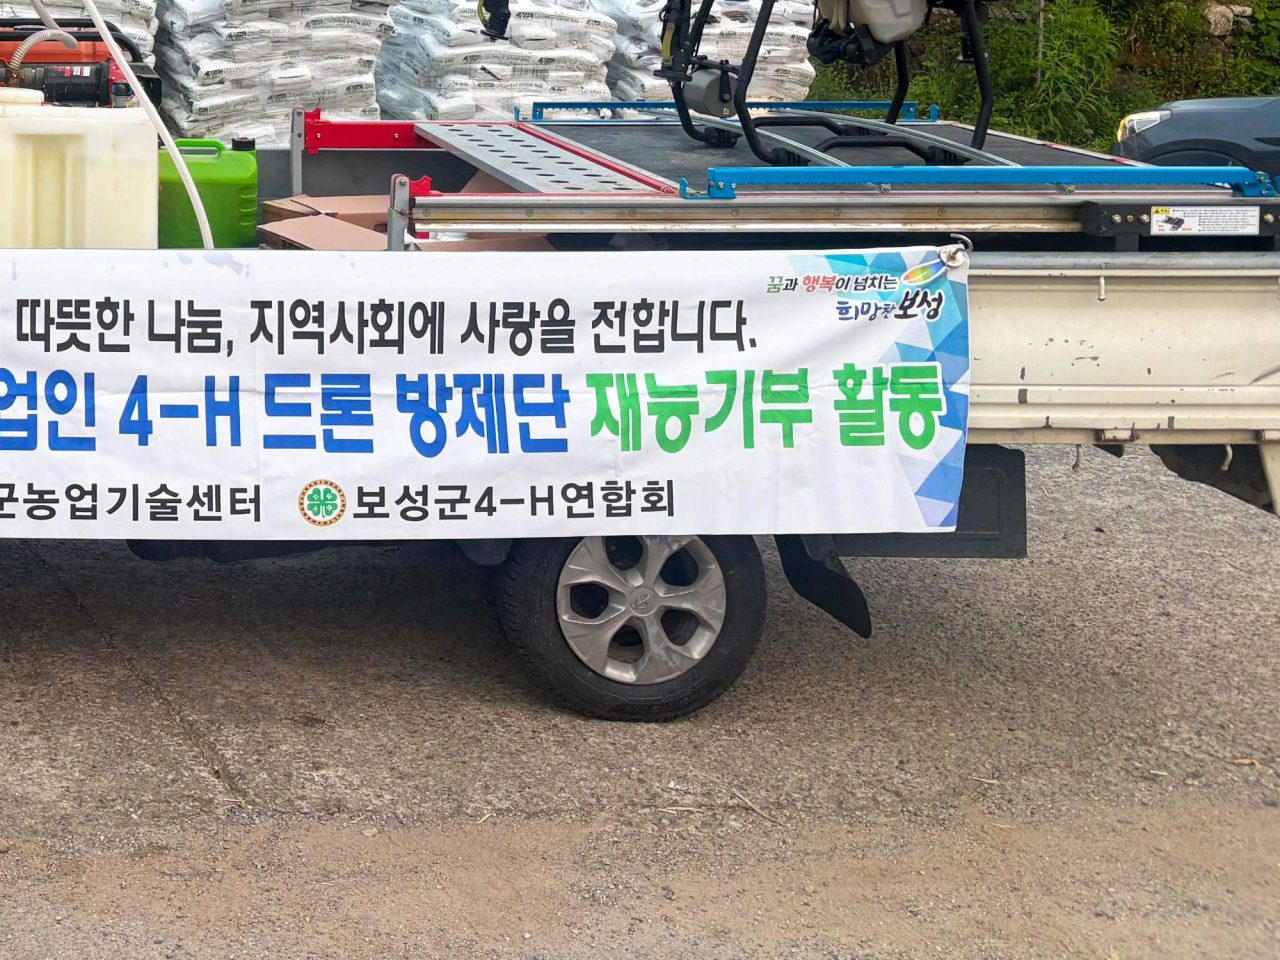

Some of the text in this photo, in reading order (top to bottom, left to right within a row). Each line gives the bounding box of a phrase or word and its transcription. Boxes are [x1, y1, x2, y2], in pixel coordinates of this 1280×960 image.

[766, 274, 899, 293] 꿈과 행복이 넘치는
[894, 289, 943, 321] 보성
[17, 297, 134, 352] 따뜻한
[149, 300, 232, 356] 나눔,
[251, 299, 444, 354] 지역사회에
[461, 299, 575, 356] 사랑을
[592, 298, 756, 353] 전합니다.
[118, 374, 242, 448] 4-H
[262, 373, 375, 451] 드론
[396, 370, 570, 459] 방제단
[586, 367, 812, 453] 재능기부
[832, 362, 946, 452] 활동
[354, 480, 673, 521] 보성군4-H연합회
